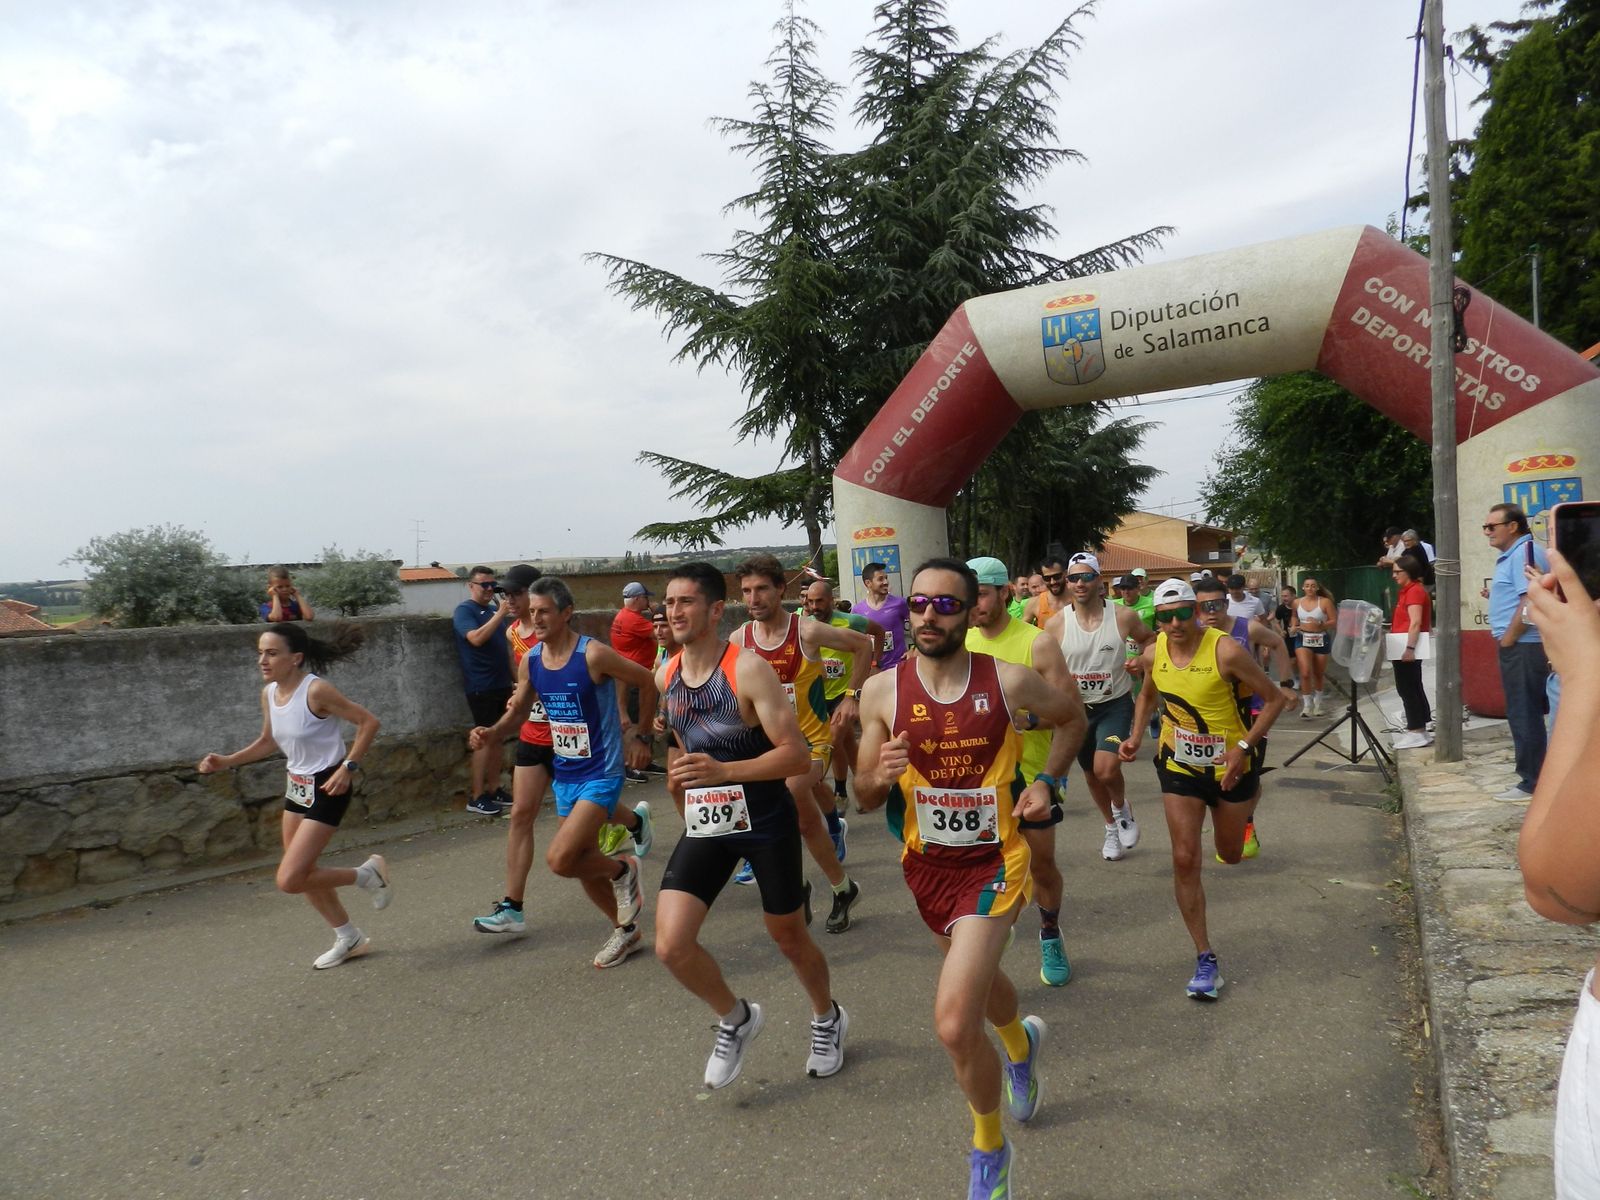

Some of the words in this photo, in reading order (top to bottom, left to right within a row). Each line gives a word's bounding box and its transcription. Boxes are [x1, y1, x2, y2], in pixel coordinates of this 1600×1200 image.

[1110, 290, 1240, 331] Diputación
[1114, 344, 1135, 360] de
[1143, 316, 1271, 354] Salamanca
[1364, 277, 1415, 314] CON
[1413, 308, 1541, 392] NSTROS
[863, 446, 896, 484] CON
[892, 426, 915, 448] EL
[911, 341, 978, 424] DEPORTE
[1081, 681, 1105, 690] 397
[556, 735, 579, 749] 341
[960, 737, 990, 748] RURAL
[1184, 743, 1215, 757] 350
[940, 754, 972, 767] VINO
[930, 769, 948, 780] DE
[949, 764, 984, 778] TORO
[687, 790, 744, 805] bedunia
[916, 790, 995, 808] bedunia
[698, 804, 733, 825] 369
[932, 809, 980, 832] 368
